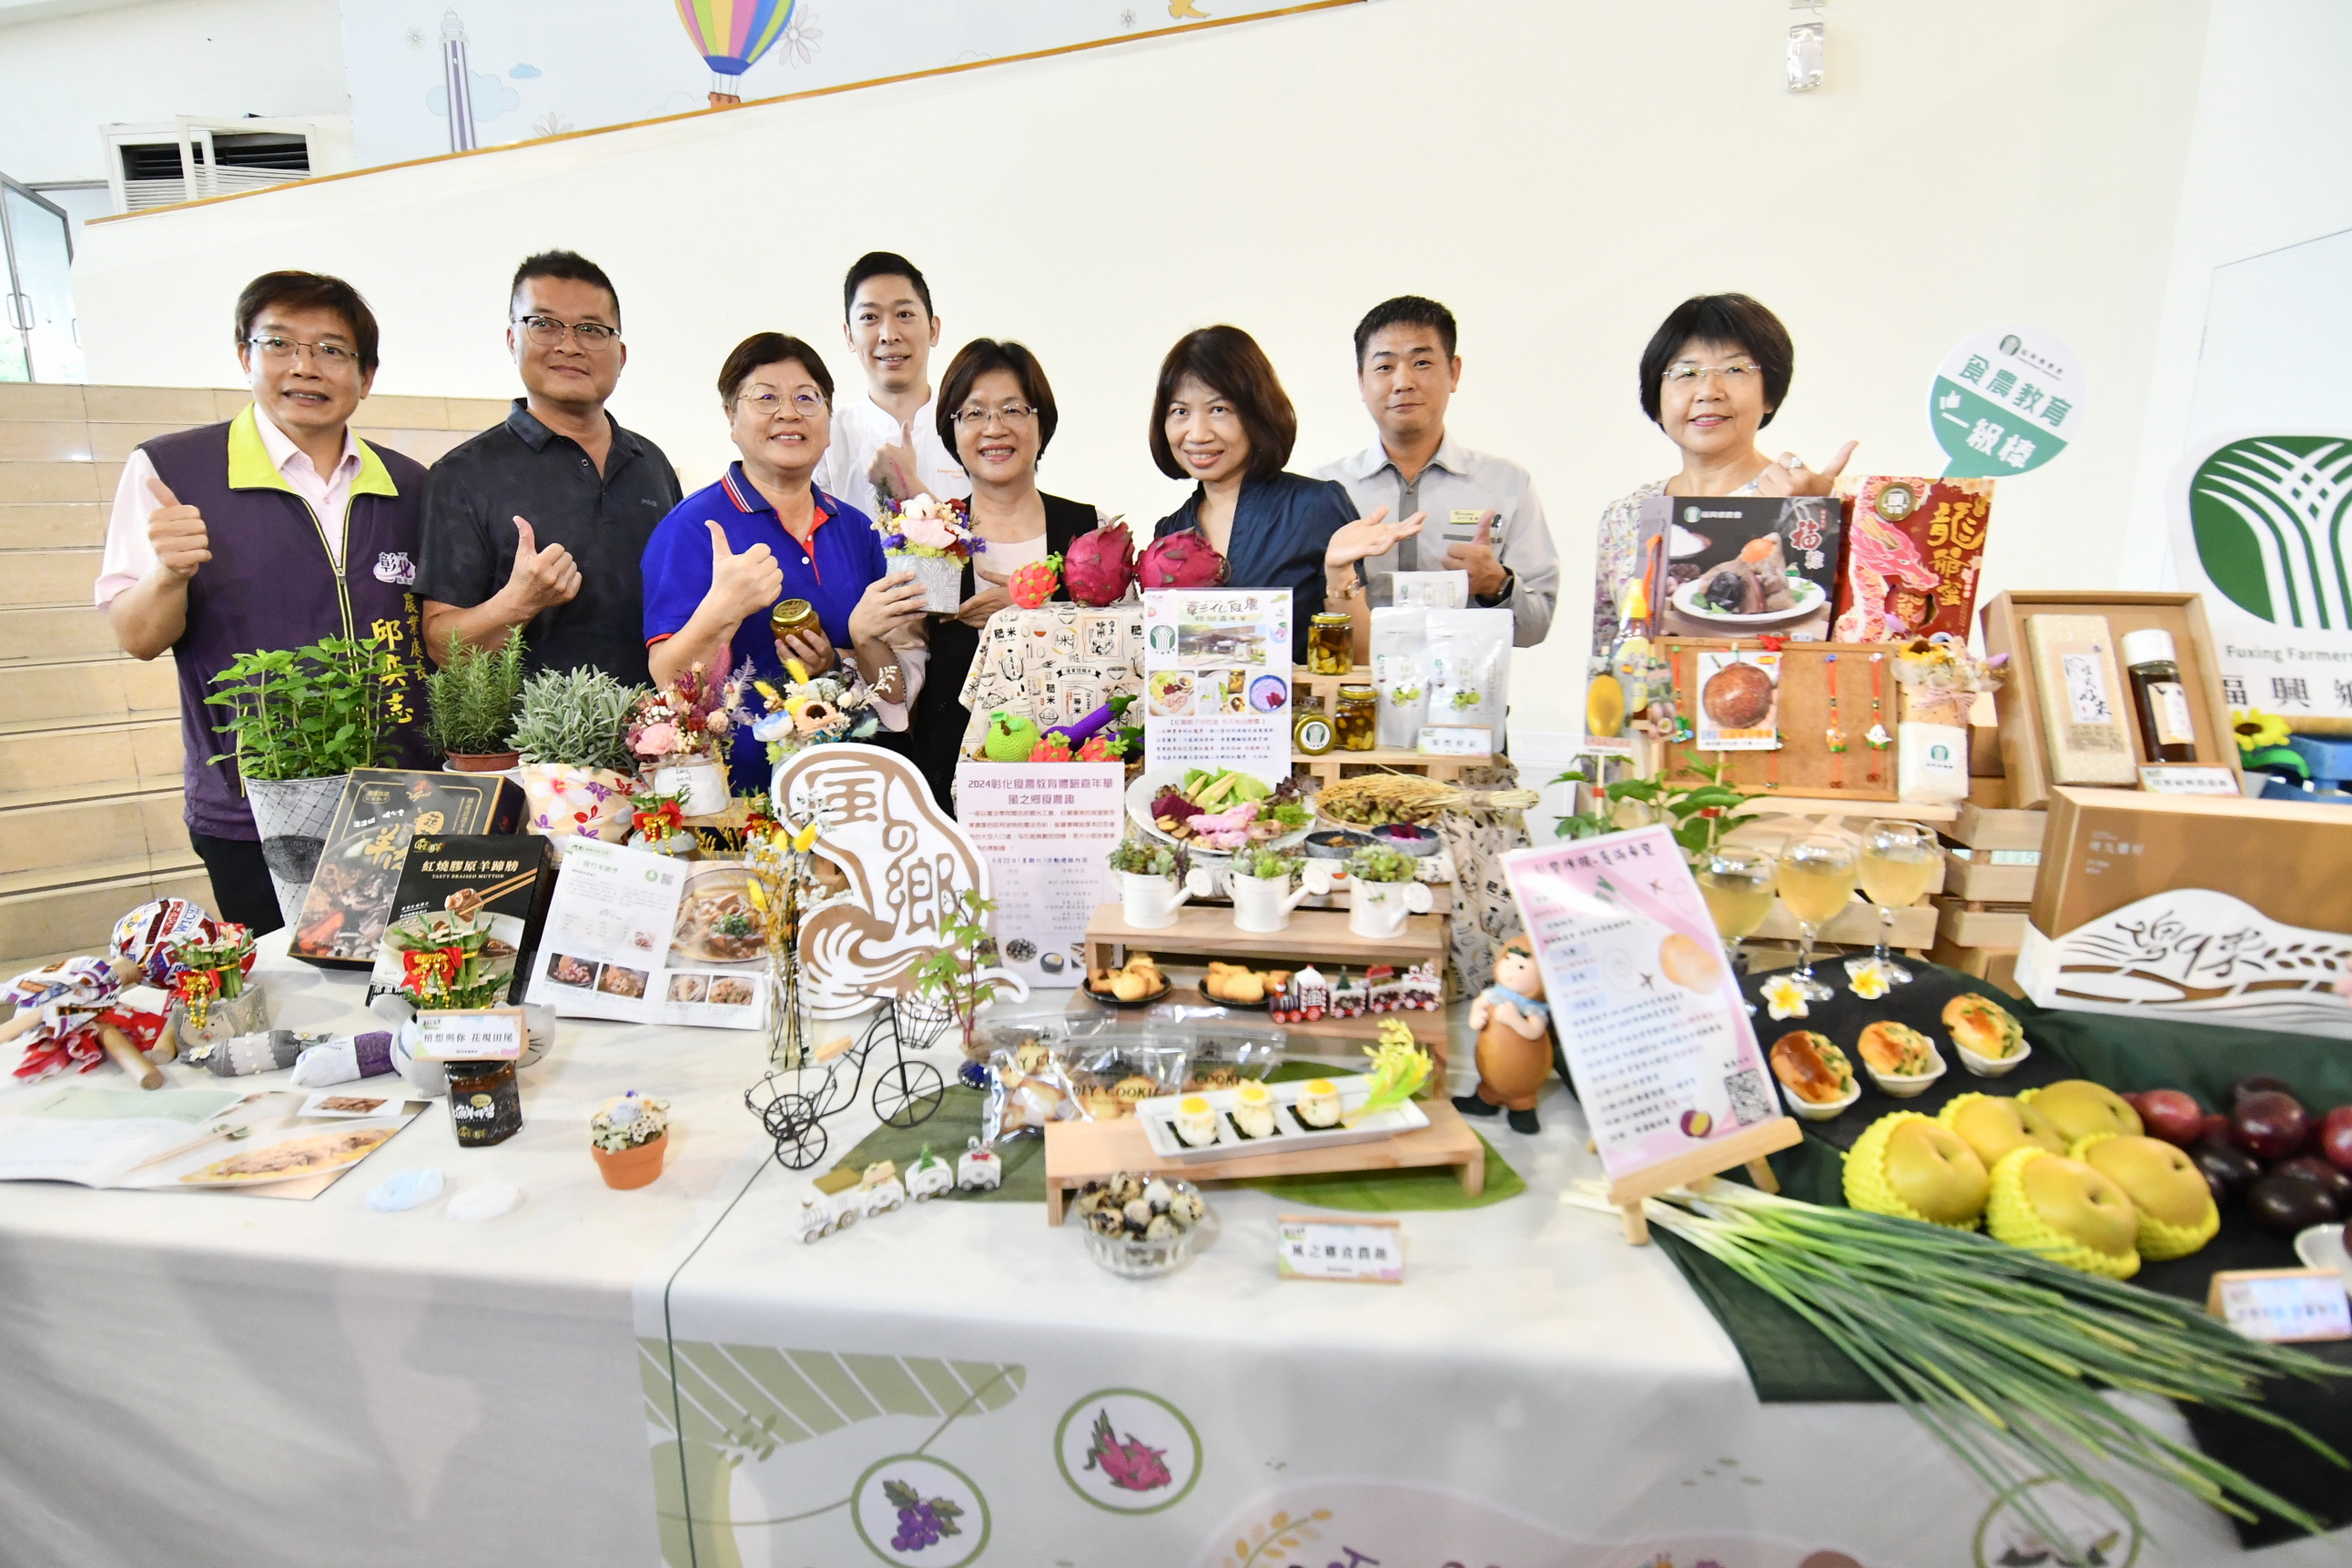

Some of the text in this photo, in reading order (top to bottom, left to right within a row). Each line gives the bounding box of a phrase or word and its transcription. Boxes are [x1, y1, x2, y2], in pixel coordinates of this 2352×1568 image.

[1959, 353, 2073, 428] 食農教育
[1941, 411, 2037, 470] 一級棒
[2226, 645, 2352, 663] Fuxing Farmer
[968, 778, 1114, 790] 2024彰化食農教育體驗嘉年華
[471, 1032, 513, 1043] 花現田尾
